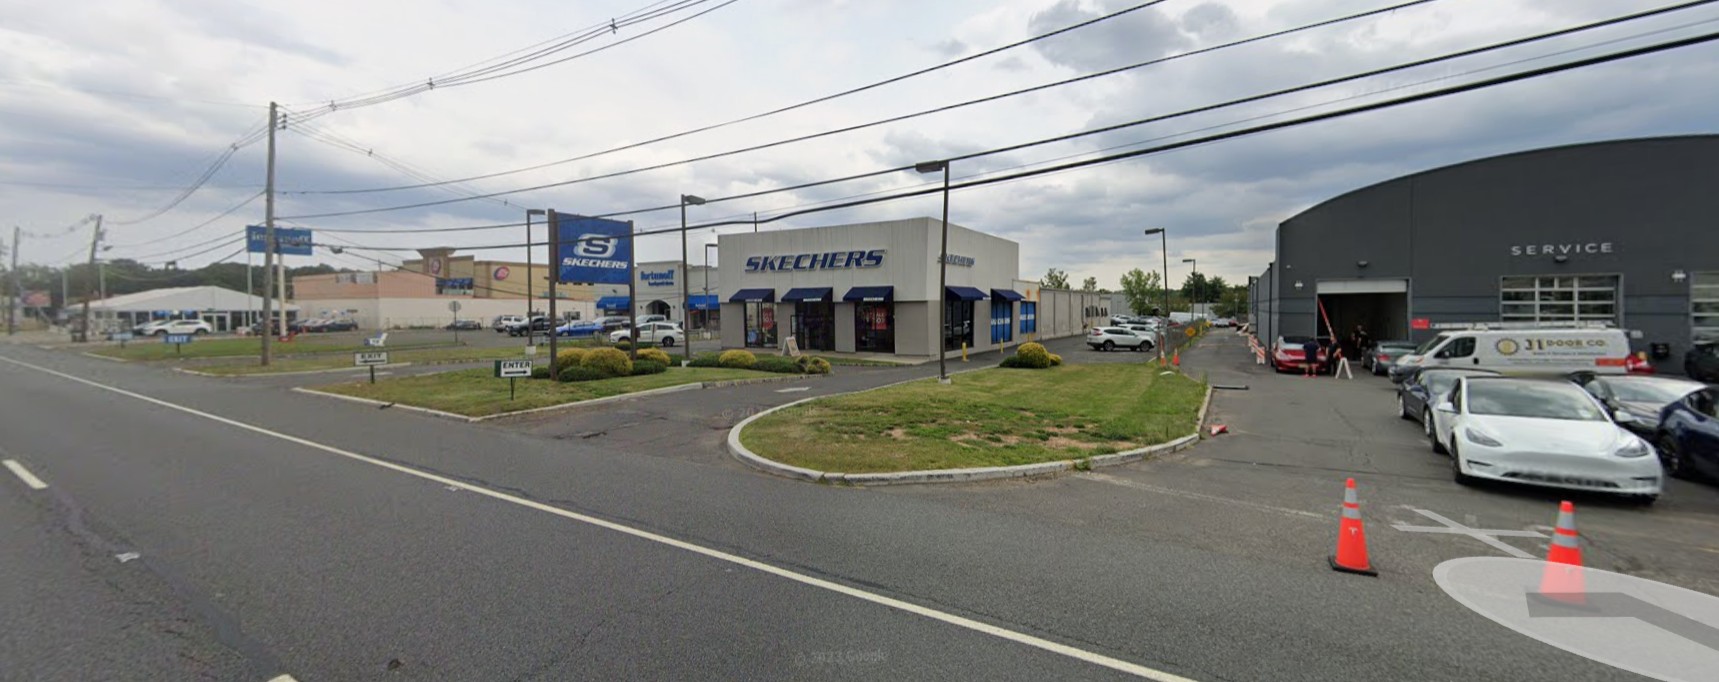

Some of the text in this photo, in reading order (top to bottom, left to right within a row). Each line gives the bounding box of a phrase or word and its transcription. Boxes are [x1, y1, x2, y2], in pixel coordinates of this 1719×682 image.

[1510, 242, 1614, 255] SERVICE
[562, 257, 628, 269] SKECHERS
[744, 249, 887, 273] SKECHERS
[1546, 339, 1584, 347] DOOR
[502, 361, 531, 369] ENTER
